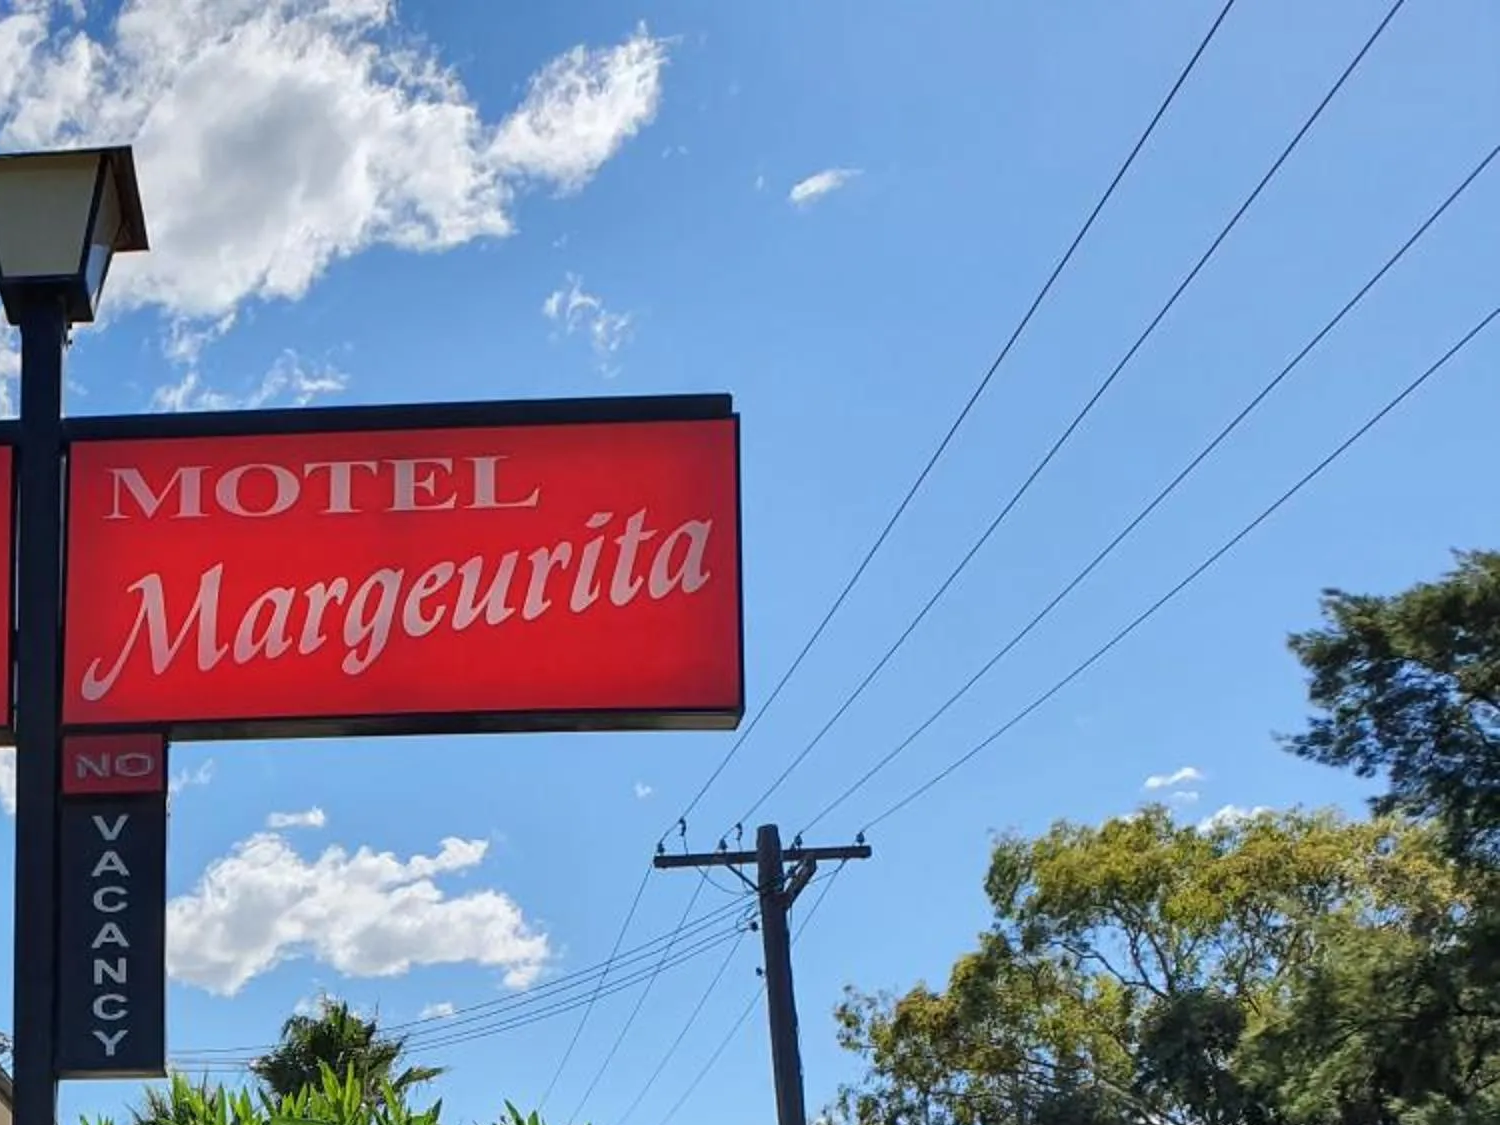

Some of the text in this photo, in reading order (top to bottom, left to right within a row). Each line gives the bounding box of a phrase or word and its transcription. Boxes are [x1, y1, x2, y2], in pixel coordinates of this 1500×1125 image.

[103, 456, 540, 519] MOTEL
[81, 507, 712, 701] Margeurita
[76, 752, 155, 778] NO
[91, 814, 130, 1057] VACANCY
